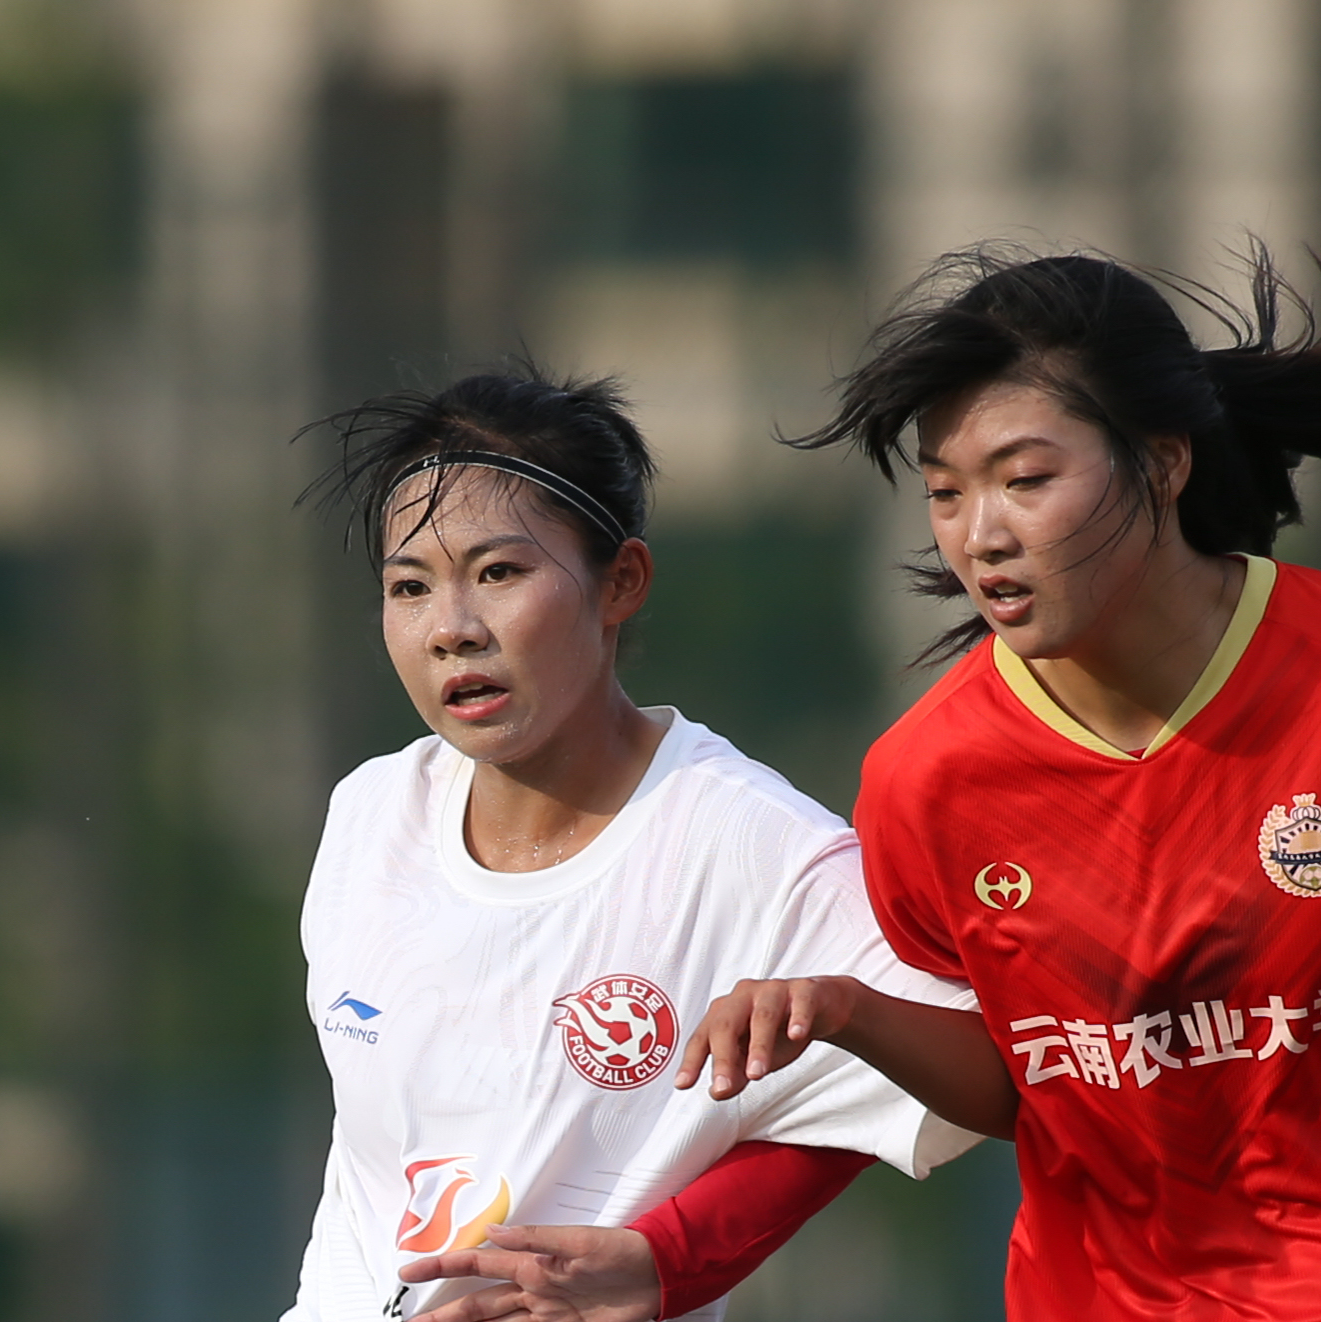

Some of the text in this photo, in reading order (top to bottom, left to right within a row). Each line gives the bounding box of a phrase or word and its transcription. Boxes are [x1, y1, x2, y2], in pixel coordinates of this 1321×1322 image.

[324, 1017, 380, 1045] LI-NING
[569, 1035, 669, 1084] FOOTBALL CLUB
